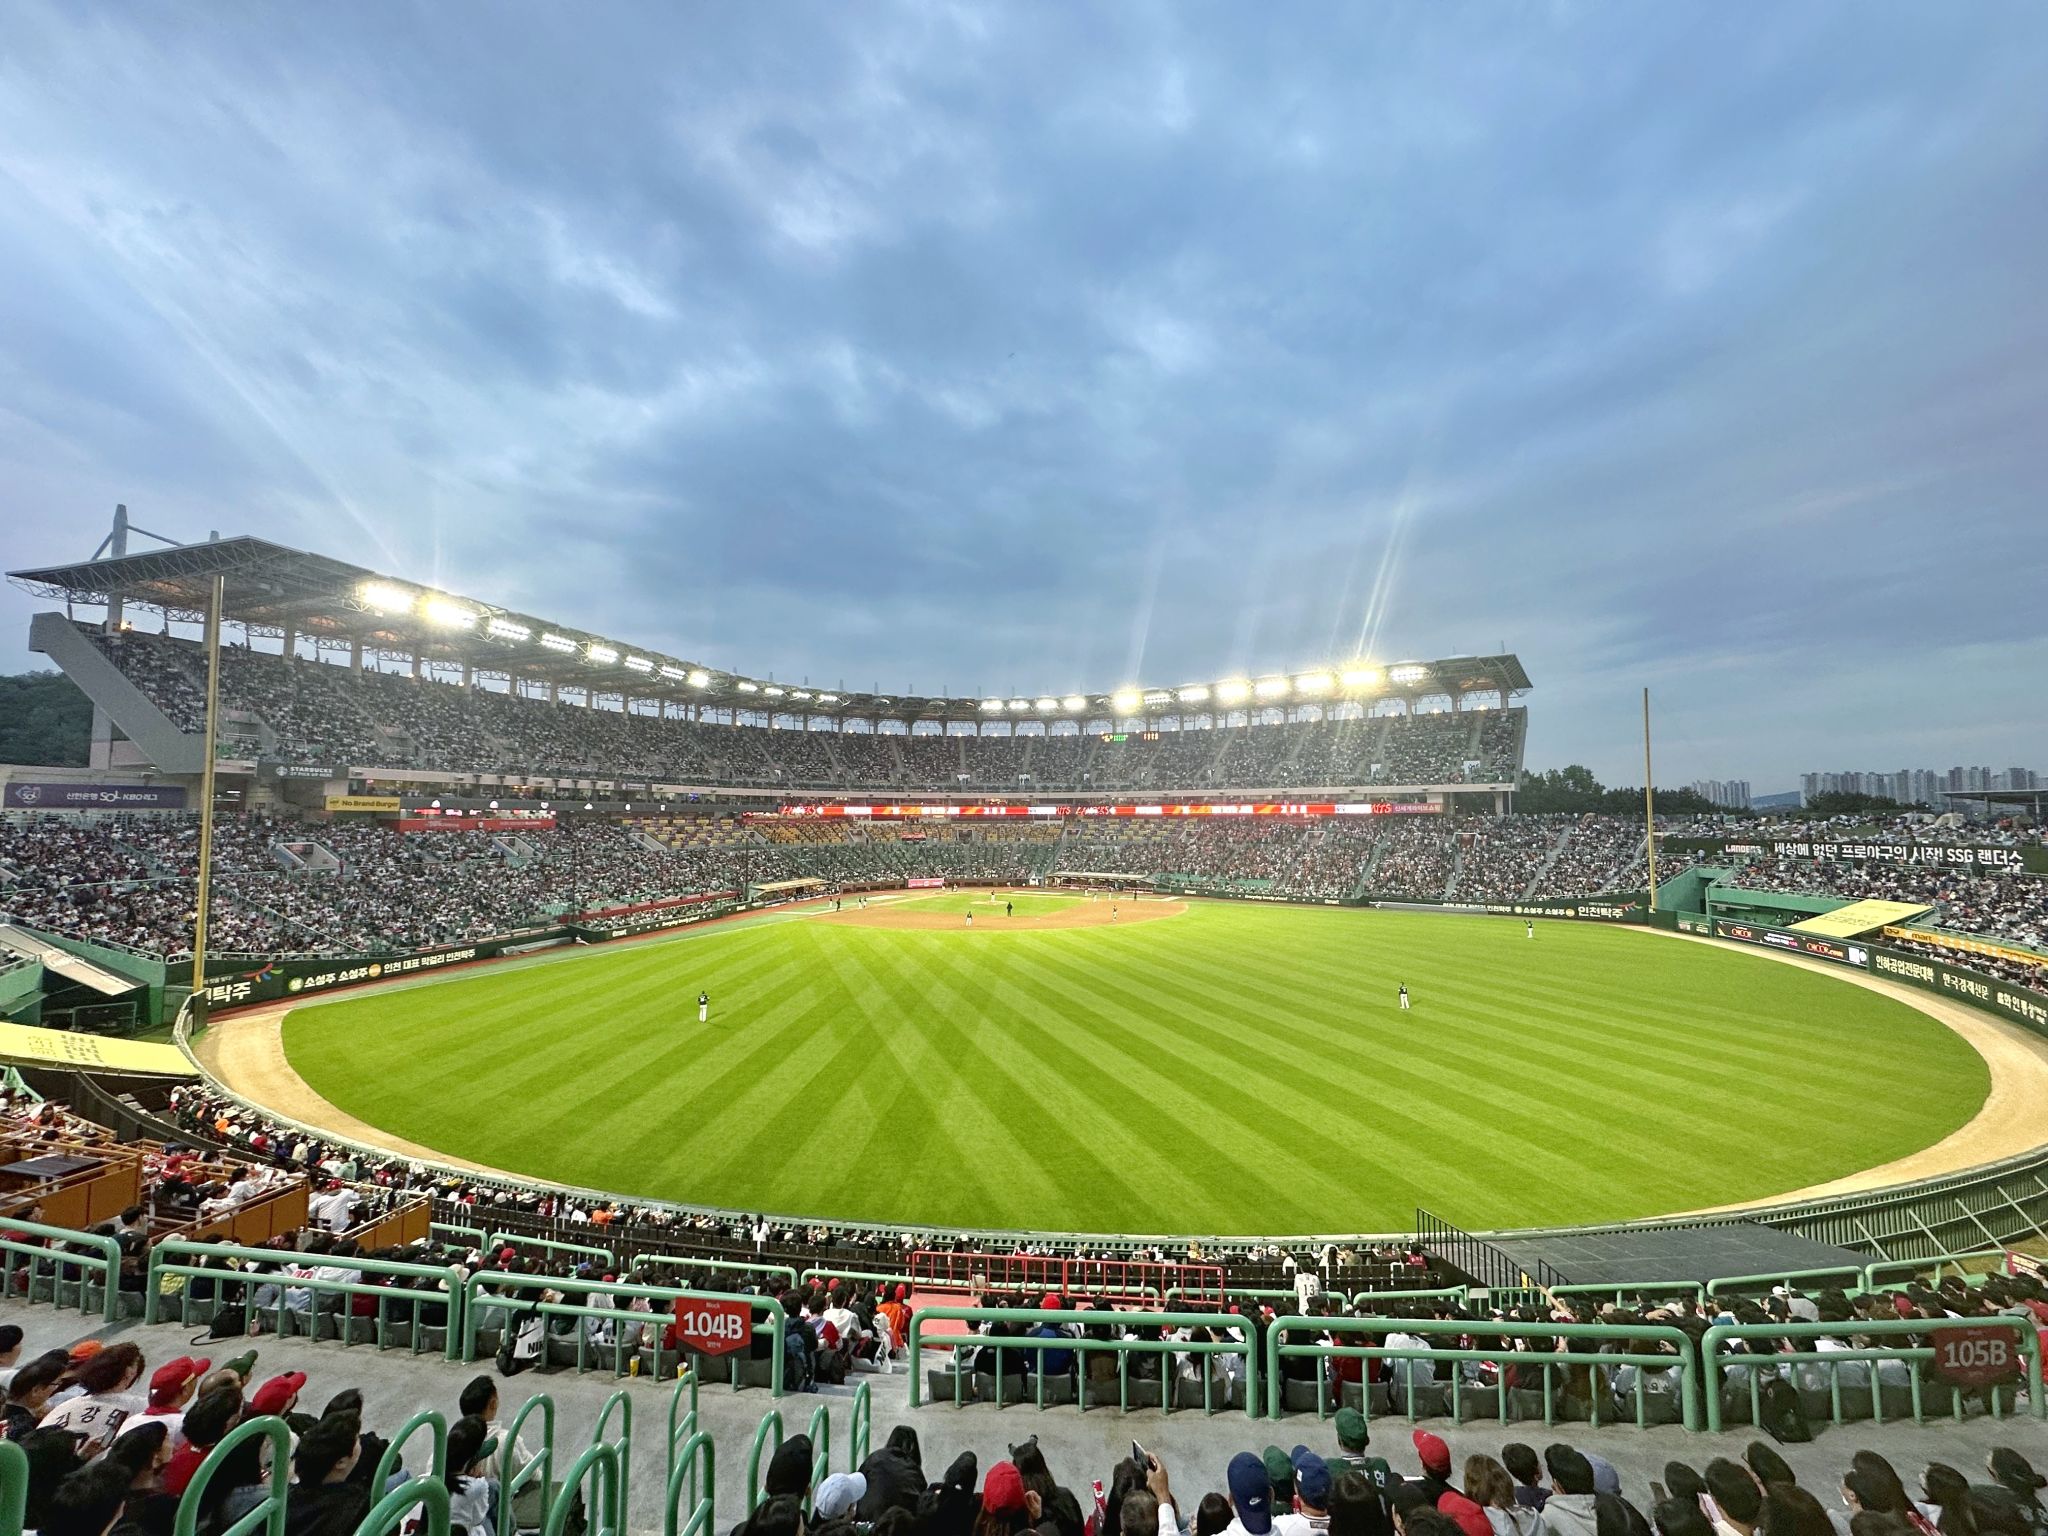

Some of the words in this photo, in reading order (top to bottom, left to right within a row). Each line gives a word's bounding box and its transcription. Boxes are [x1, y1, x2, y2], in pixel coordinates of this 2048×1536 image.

[290, 766, 332, 774] STARBUCKS
[66, 792, 98, 800] 신한은행
[100, 790, 121, 802] SOL
[122, 793, 143, 801] KBO
[376, 800, 398, 808] Burger
[1774, 842, 1809, 857] 세상에
[1812, 844, 1837, 857] 없던
[1841, 844, 1907, 860] 프로야구의
[1947, 849, 1974, 863] SSG
[1977, 849, 2024, 867] 랜더스
[1578, 906, 1624, 918] 인천탁주
[383, 962, 402, 974] 인천
[402, 961, 420, 969] 대표
[421, 955, 445, 966] 막걸리
[1875, 955, 1934, 983] 인하공업전문대학
[304, 973, 336, 988] 소성주
[338, 967, 369, 982] 소성주
[1942, 973, 1989, 1000] 한국경제신문
[683, 1311, 743, 1340] 104B
[1944, 1340, 2007, 1368] 105B
